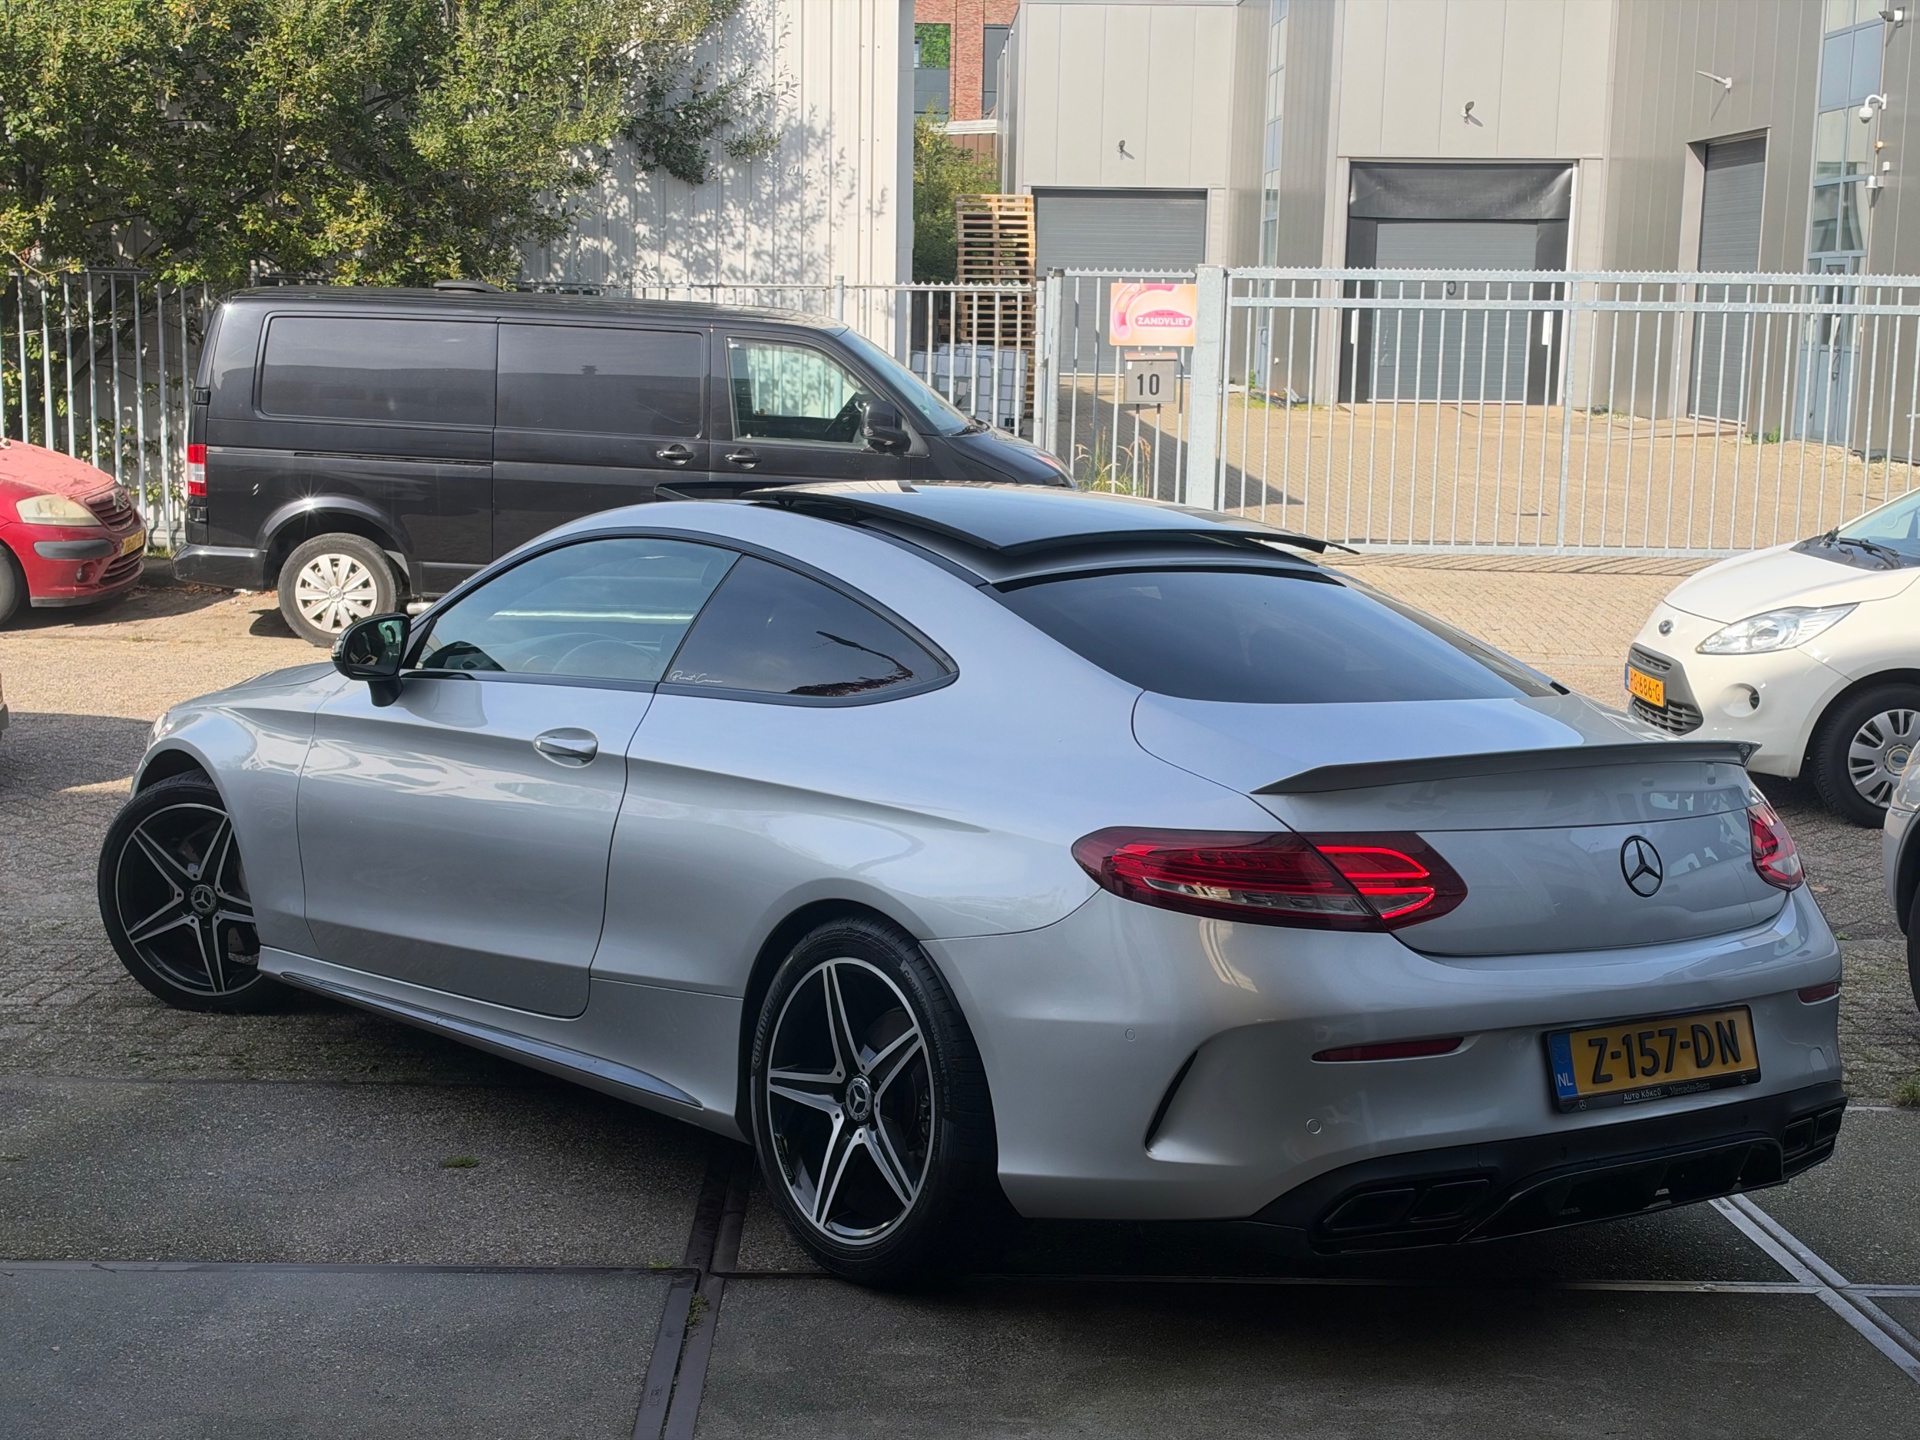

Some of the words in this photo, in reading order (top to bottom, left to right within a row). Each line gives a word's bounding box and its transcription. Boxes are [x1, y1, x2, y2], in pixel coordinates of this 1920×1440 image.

[1137, 316, 1191, 326] ZANDVLIET
[1137, 373, 1160, 396] 10
[1588, 1019, 1741, 1084] Z-157-DN
[1557, 1072, 1573, 1087] NL
